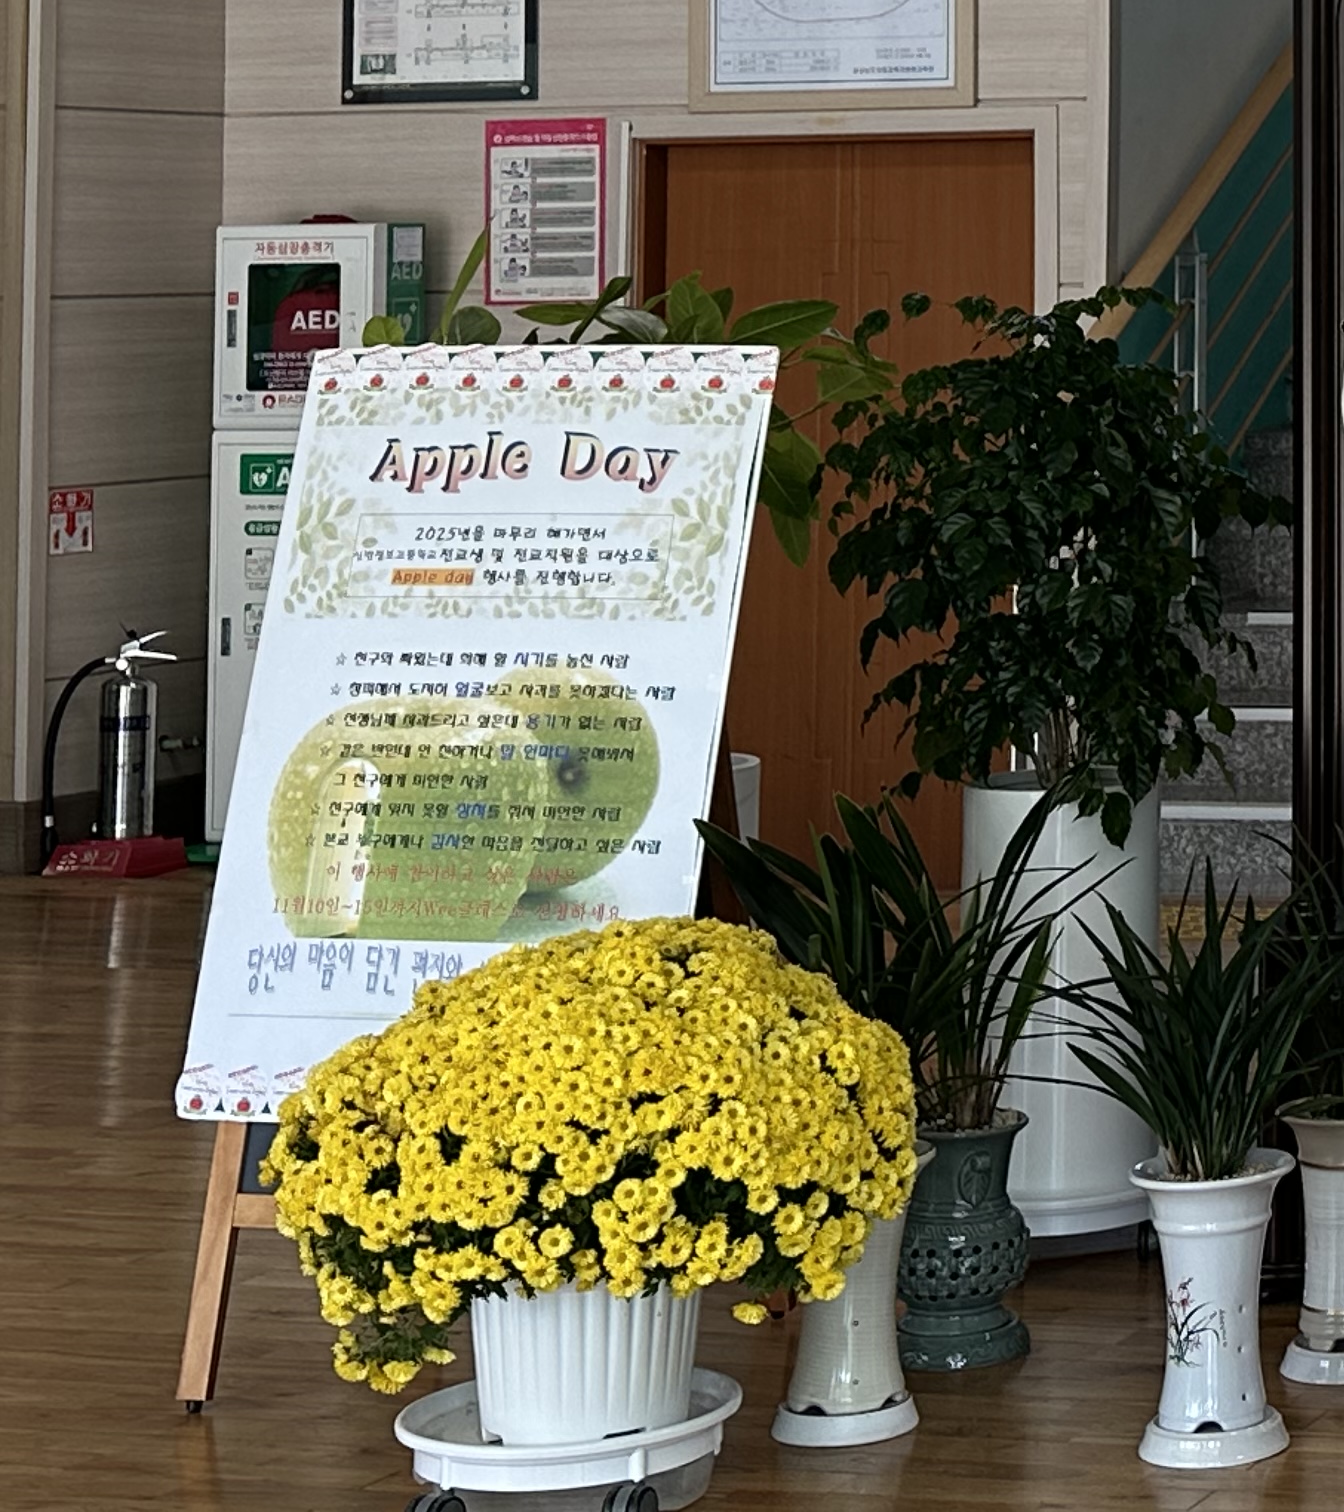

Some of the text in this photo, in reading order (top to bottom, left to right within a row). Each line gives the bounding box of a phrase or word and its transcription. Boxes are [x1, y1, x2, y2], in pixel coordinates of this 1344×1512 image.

[391, 263, 423, 281] AED
[290, 309, 340, 331] AED
[370, 431, 681, 494] Apple Day
[414, 525, 486, 542] 2025년을
[493, 526, 538, 541] 마무리
[491, 548, 505, 563] 및
[513, 547, 589, 563] 전교직원을
[597, 548, 660, 563] 대상으로
[391, 569, 440, 587] Apple
[444, 569, 475, 586] day
[482, 568, 528, 587] 행사를
[353, 651, 394, 667] 친구와
[513, 651, 559, 668] 시기를
[566, 652, 594, 669] 놓친
[599, 652, 630, 669] 사람
[349, 681, 402, 697] 창피해서
[518, 683, 562, 699] 사과를
[644, 685, 677, 701] 사람
[343, 711, 643, 732] 선생님께 사과드리고 싶은데 용기가 없는 사람
[339, 743, 365, 759] 같은
[370, 743, 412, 759] 반인데
[522, 743, 570, 761] 한마디
[333, 772, 490, 790] 그 친구에게 미안한 사람
[328, 801, 382, 817] 친구에게
[542, 805, 587, 822] 미안한
[591, 806, 623, 822] 사람
[431, 832, 476, 850] 감사한
[481, 834, 524, 852] 마음을
[631, 839, 662, 855] 사람
[325, 861, 342, 882] 이
[247, 942, 297, 995] 당신의
[308, 940, 355, 990] 마음이
[365, 944, 401, 996] 담긴
